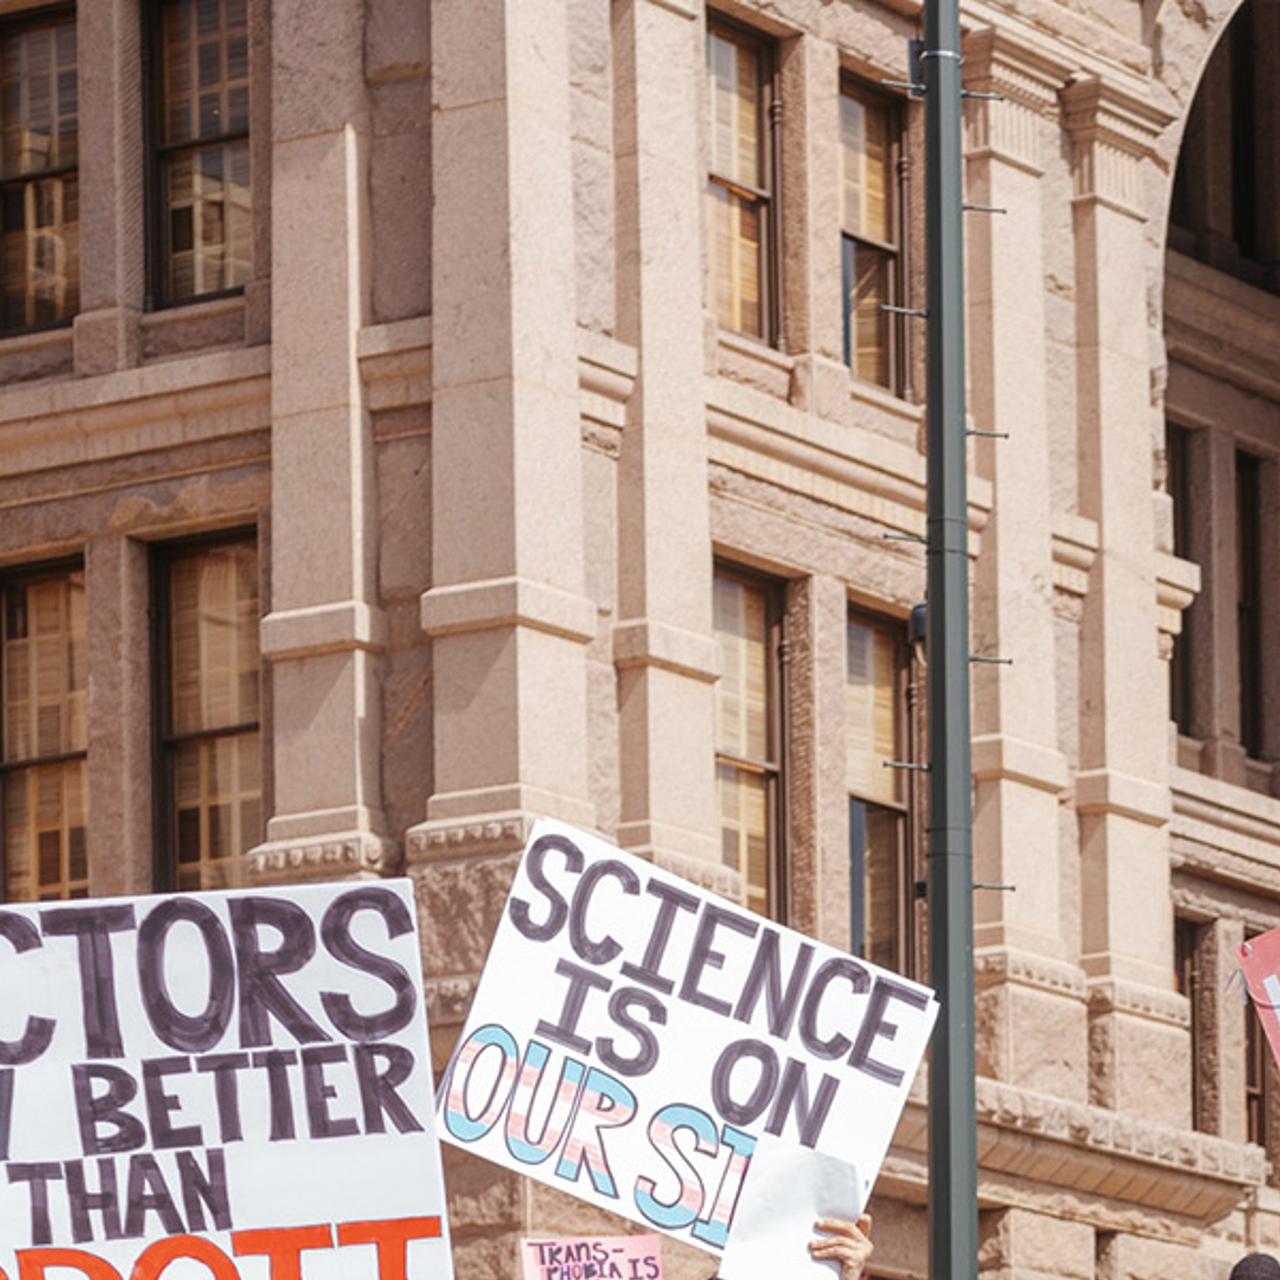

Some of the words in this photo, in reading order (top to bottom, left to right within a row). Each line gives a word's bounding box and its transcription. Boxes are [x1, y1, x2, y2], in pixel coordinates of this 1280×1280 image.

[0, 887, 417, 1064] CTORS
[509, 834, 929, 1086] SCIENCE
[71, 1044, 425, 1156] BETTER
[444, 1024, 638, 1199] OUR
[535, 958, 667, 1077] IS
[711, 1038, 840, 1149] ON
[7, 1149, 233, 1245] THAN
[628, 1256, 660, 1280] IS
